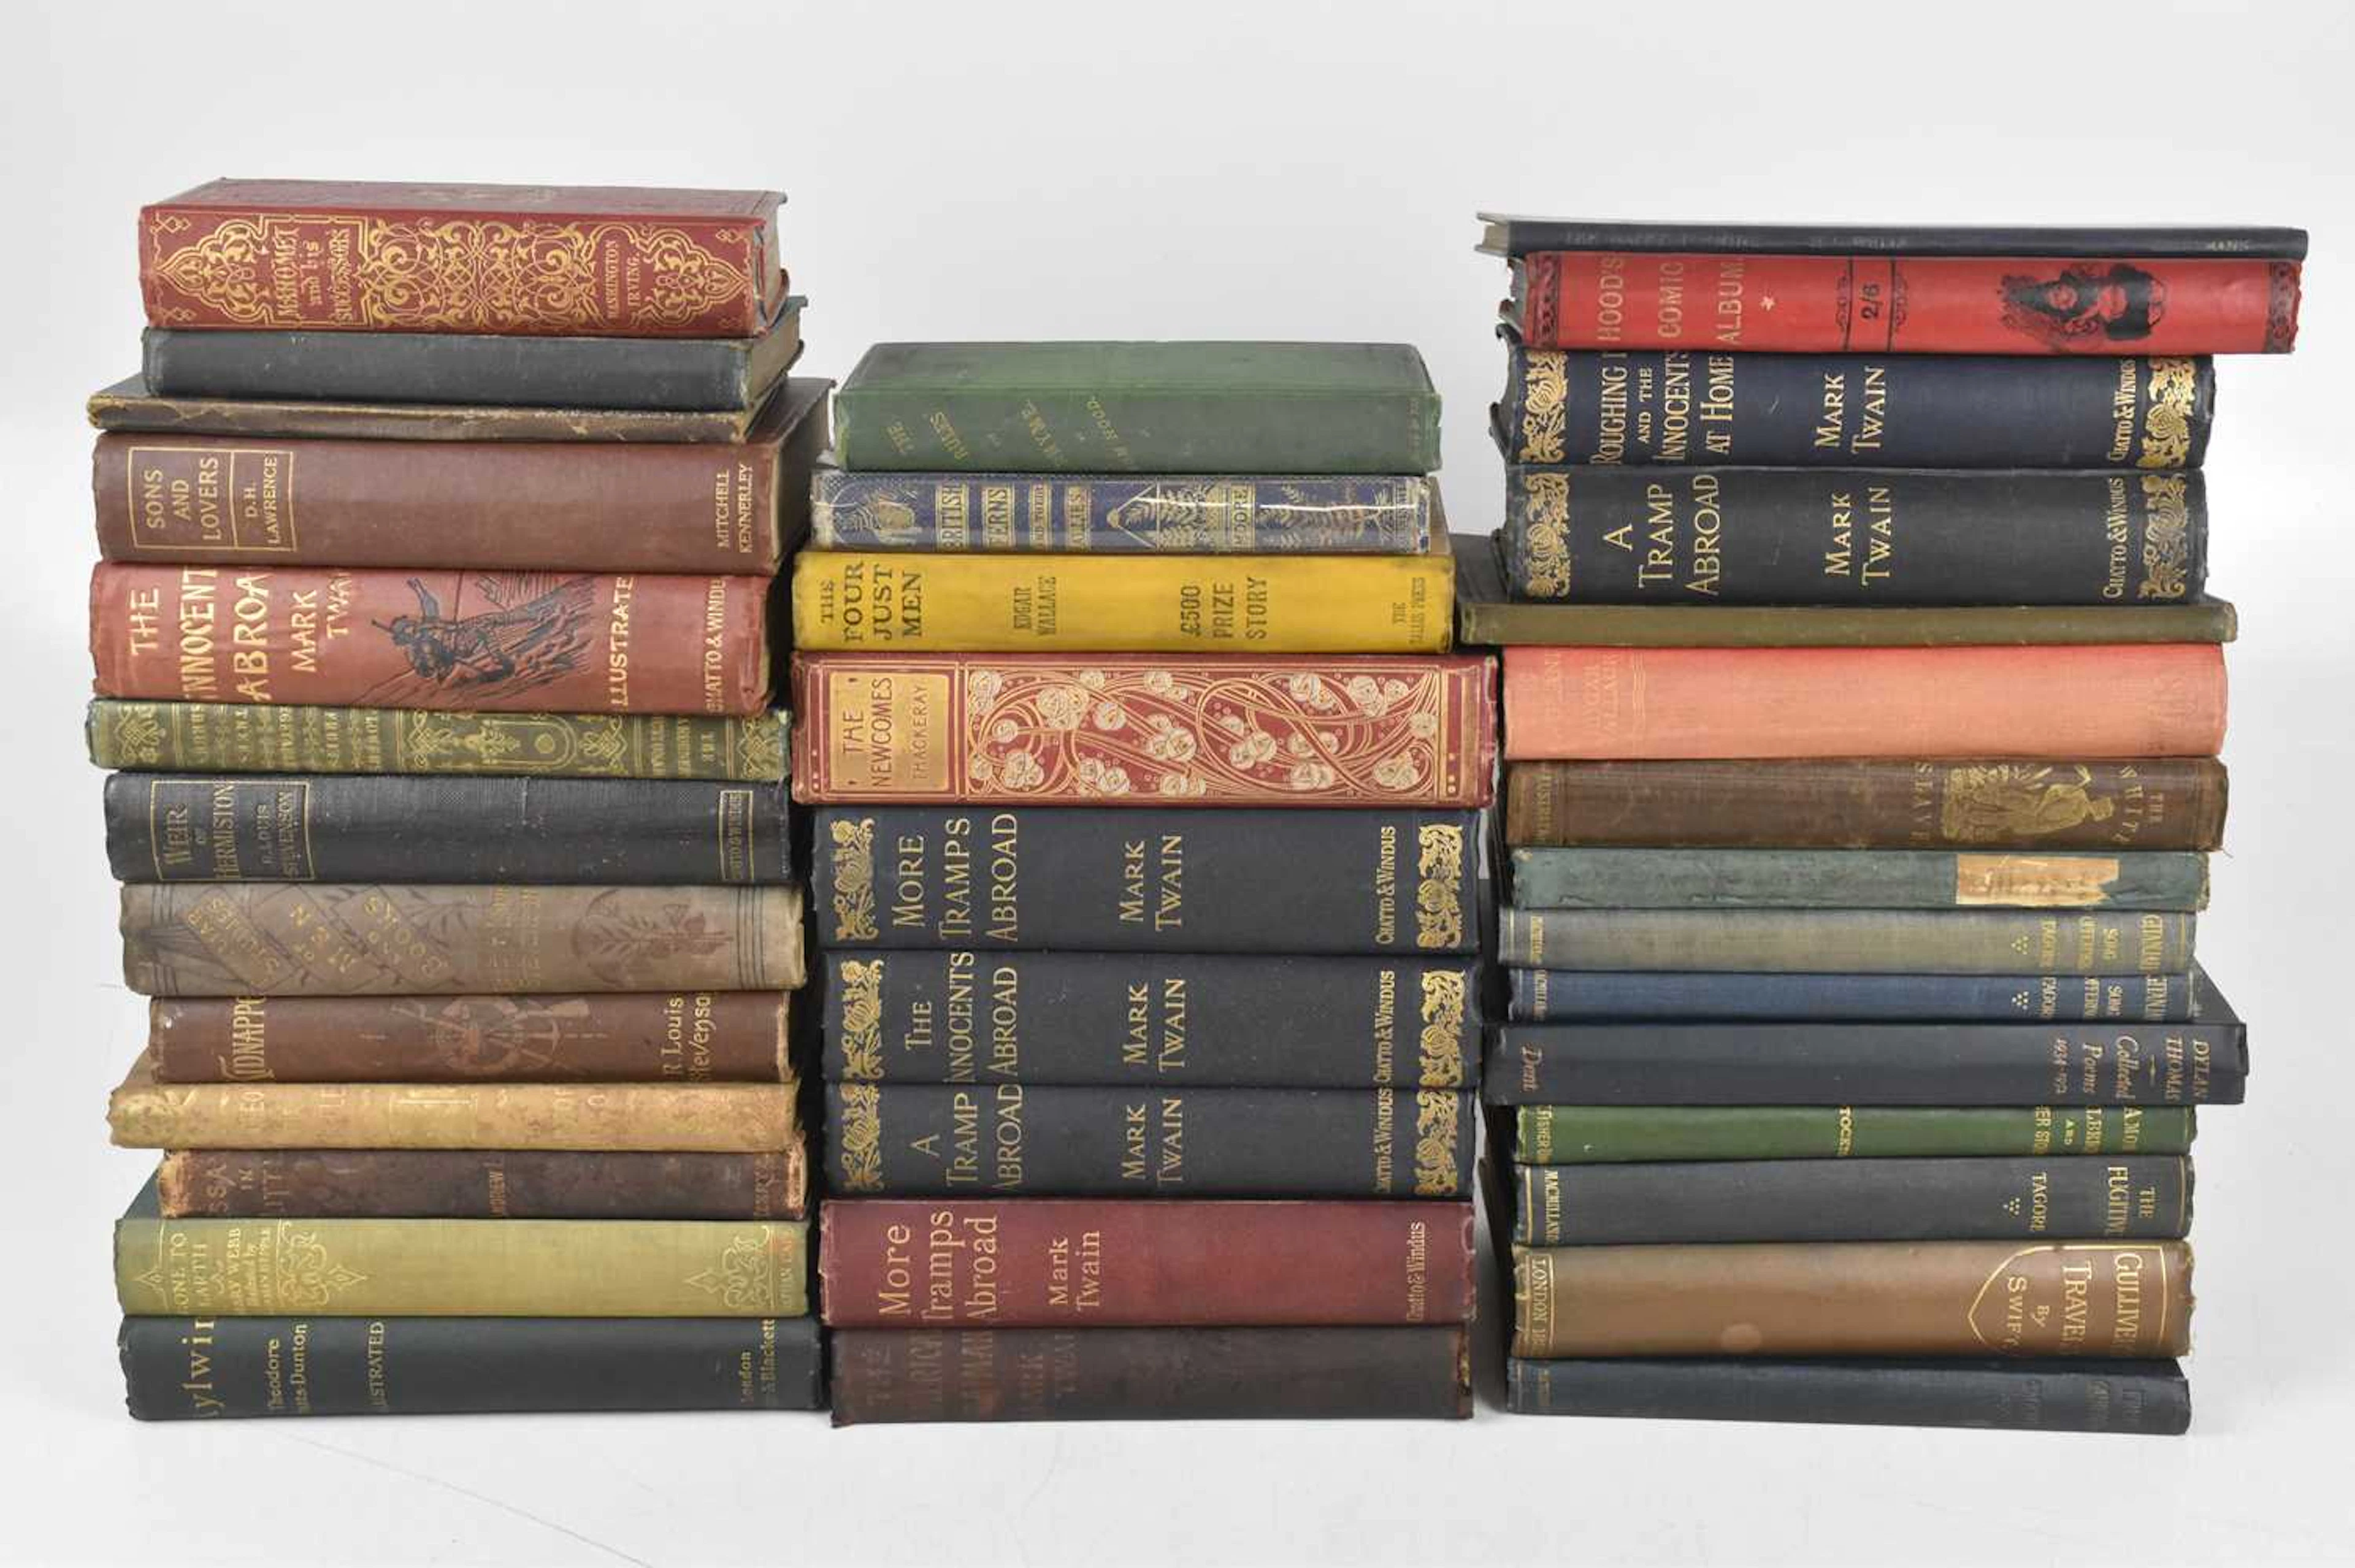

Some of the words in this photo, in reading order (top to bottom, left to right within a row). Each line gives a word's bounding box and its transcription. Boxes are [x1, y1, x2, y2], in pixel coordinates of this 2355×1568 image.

[1658, 262, 1684, 338] COMIC
[1715, 261, 1744, 344] ALBUM
[1859, 284, 1883, 319] 2/6
[1590, 367, 1628, 465] ROUGHING
[1638, 367, 1653, 403] THE
[1699, 356, 1734, 421] HOME
[1814, 373, 1845, 448] MARK
[1850, 365, 1886, 454] TWAIN
[2112, 405, 2135, 419] &
[1637, 411, 1652, 443] AND
[1706, 430, 1731, 454] AT
[2107, 419, 2134, 461] CHATTO
[144, 468, 164, 529] SONS
[172, 480, 191, 521] AND
[199, 457, 221, 540] LOVERS
[264, 456, 281, 544] LAWRENCE
[716, 469, 730, 549] MITCHELL
[738, 463, 754, 553] KENNERLEY
[2106, 477, 2128, 529] WINDUS
[1603, 522, 1633, 553] A
[1638, 484, 1674, 589] TRAMP
[1684, 474, 1721, 596] ABROAD
[1825, 492, 1851, 576] MARK
[1861, 487, 1891, 586] TWAIN
[2106, 527, 2127, 543] &
[820, 579, 834, 623] THE
[844, 562, 864, 642] FOUR
[873, 564, 892, 640] JUST
[2102, 545, 2127, 599] CHATTO
[129, 587, 159, 655] THE
[291, 589, 318, 673] MARK
[706, 578, 726, 631] WINDU
[901, 571, 921, 638] MEN
[1014, 587, 1032, 630] EDGAR
[1039, 576, 1055, 636] WALLACE
[1180, 586, 1201, 637] £500
[1213, 583, 1234, 638] PRIZE
[1246, 578, 1267, 639] STORY
[233, 573, 273, 703] ABROA
[705, 632, 723, 648] &
[843, 711, 864, 754] THE
[871, 678, 892, 787] NEWCOMES
[912, 686, 929, 779] THACKERAY
[891, 835, 925, 928] MORE
[938, 818, 971, 941] TRAMPS
[984, 814, 1018, 942] ABROAD
[1119, 841, 1144, 922] MARK
[1155, 835, 1182, 932] TWAIN
[1376, 826, 1396, 884] WINDUS
[1375, 898, 1395, 944] CHATTO
[1376, 883, 1395, 896] &
[661, 998, 683, 1055] Louis
[905, 1001, 932, 1051] THE
[986, 967, 1018, 1077] ABROAD
[1122, 982, 1148, 1064] MARK
[1157, 979, 1185, 1073] TWAIN
[1374, 970, 1395, 1028] WINDUS
[232, 998, 274, 1081] IDNAPP
[1373, 1041, 1393, 1082] CHATTO
[1375, 1027, 1393, 1040] &
[1522, 1045, 1544, 1092] Dent
[2082, 1044, 2104, 1093] Poems
[2115, 1036, 2140, 1100] Collected
[2165, 1036, 2184, 1102] THOMAS
[2192, 1039, 2210, 1098] DYLAN
[909, 1134, 940, 1158] A
[946, 1092, 978, 1187] TRAMP
[1121, 1104, 1146, 1180] MARK
[1157, 1098, 1183, 1187] TWAIN
[1373, 1087, 1394, 1144] WINDUS
[1374, 1142, 1393, 1155] &
[2107, 1166, 2129, 1233] FUGITIV
[2139, 1186, 2156, 1218] THE
[170, 1233, 187, 1258] TO
[226, 1228, 241, 1275] WEBB
[879, 1225, 911, 1315] More
[920, 1211, 965, 1322] Tramps
[963, 1215, 997, 1321] Abroad
[1048, 1237, 1068, 1306] Mark
[1075, 1230, 1100, 1312] Twain
[1406, 1222, 1425, 1273] Windus
[1531, 1259, 1548, 1321] LONDON
[2031, 1305, 2050, 1328] By
